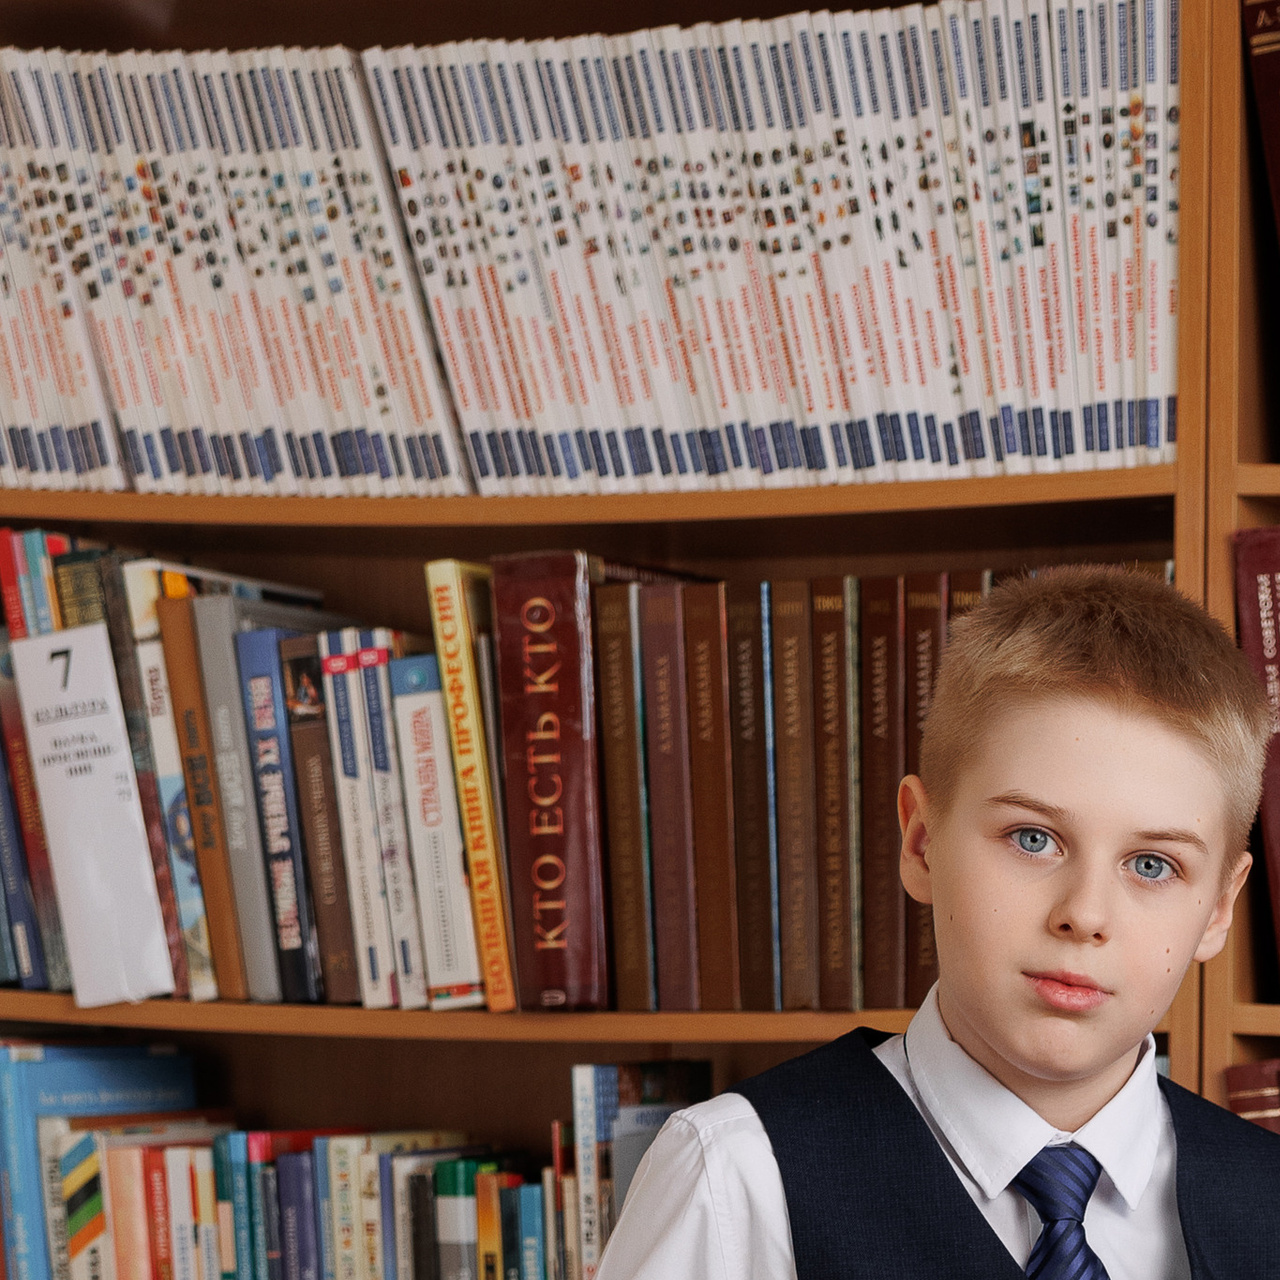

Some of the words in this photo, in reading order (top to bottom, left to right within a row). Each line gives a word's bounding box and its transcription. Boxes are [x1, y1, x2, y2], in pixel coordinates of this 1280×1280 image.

[48, 647, 73, 692] 7
[520, 596, 560, 695] КТО
[460, 764, 489, 854] КНИГА
[526, 710, 565, 838] ЕСТЬ
[531, 852, 569, 952] КТО
